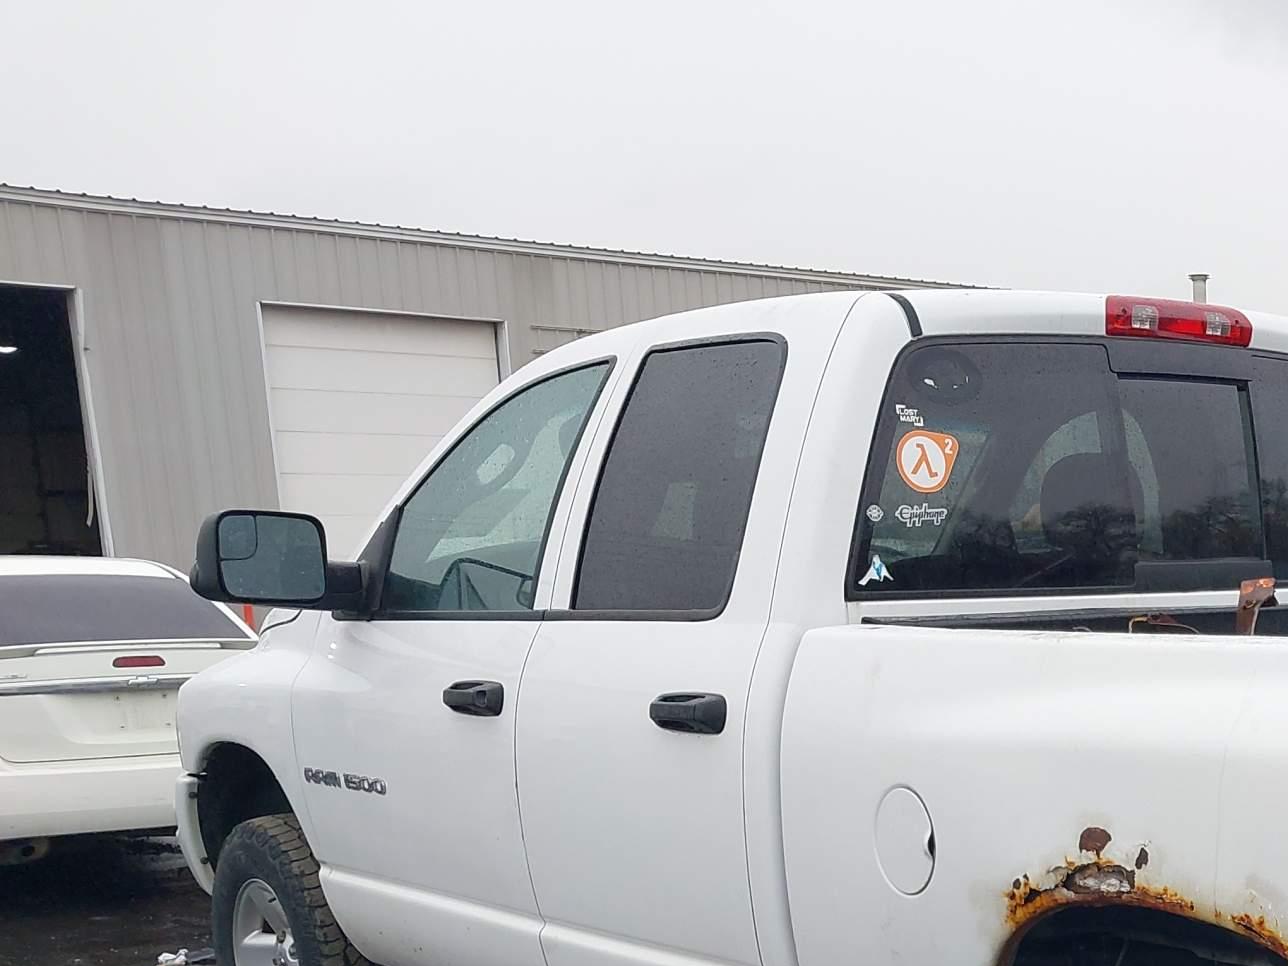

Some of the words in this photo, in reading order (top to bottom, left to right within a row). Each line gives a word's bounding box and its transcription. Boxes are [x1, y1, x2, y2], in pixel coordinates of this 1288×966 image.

[944, 438, 953, 454] 2
[303, 767, 342, 789] RAM
[342, 772, 387, 796] 1500
